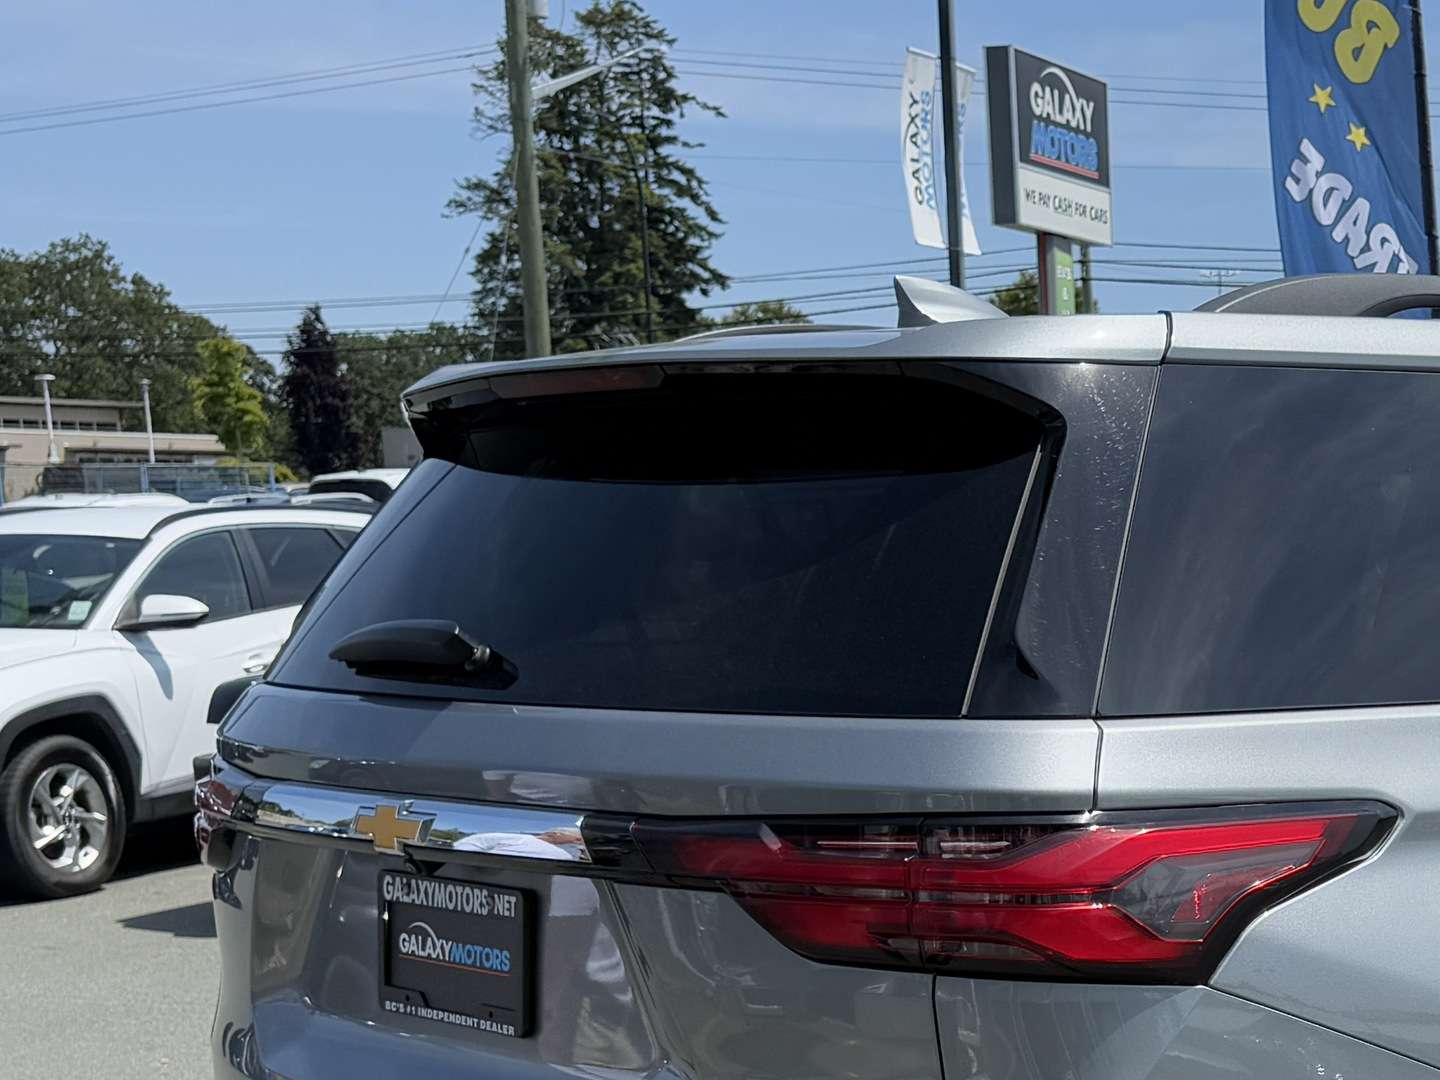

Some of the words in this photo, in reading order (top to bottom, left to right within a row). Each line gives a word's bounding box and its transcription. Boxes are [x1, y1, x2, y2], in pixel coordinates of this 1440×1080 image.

[1029, 80, 1095, 133] GALAXY
[907, 90, 924, 206] GALAXY
[1030, 119, 1099, 172] MOTORS
[1024, 187, 1036, 205] WE
[1038, 192, 1051, 208] PAY
[1053, 194, 1073, 213] CASH
[1074, 202, 1087, 218] FOR
[1089, 205, 1108, 225] CARS
[406, 1004, 416, 1015] #1
[418, 1006, 479, 1028] INDEPENDENT
[480, 1020, 515, 1036] DEALER
